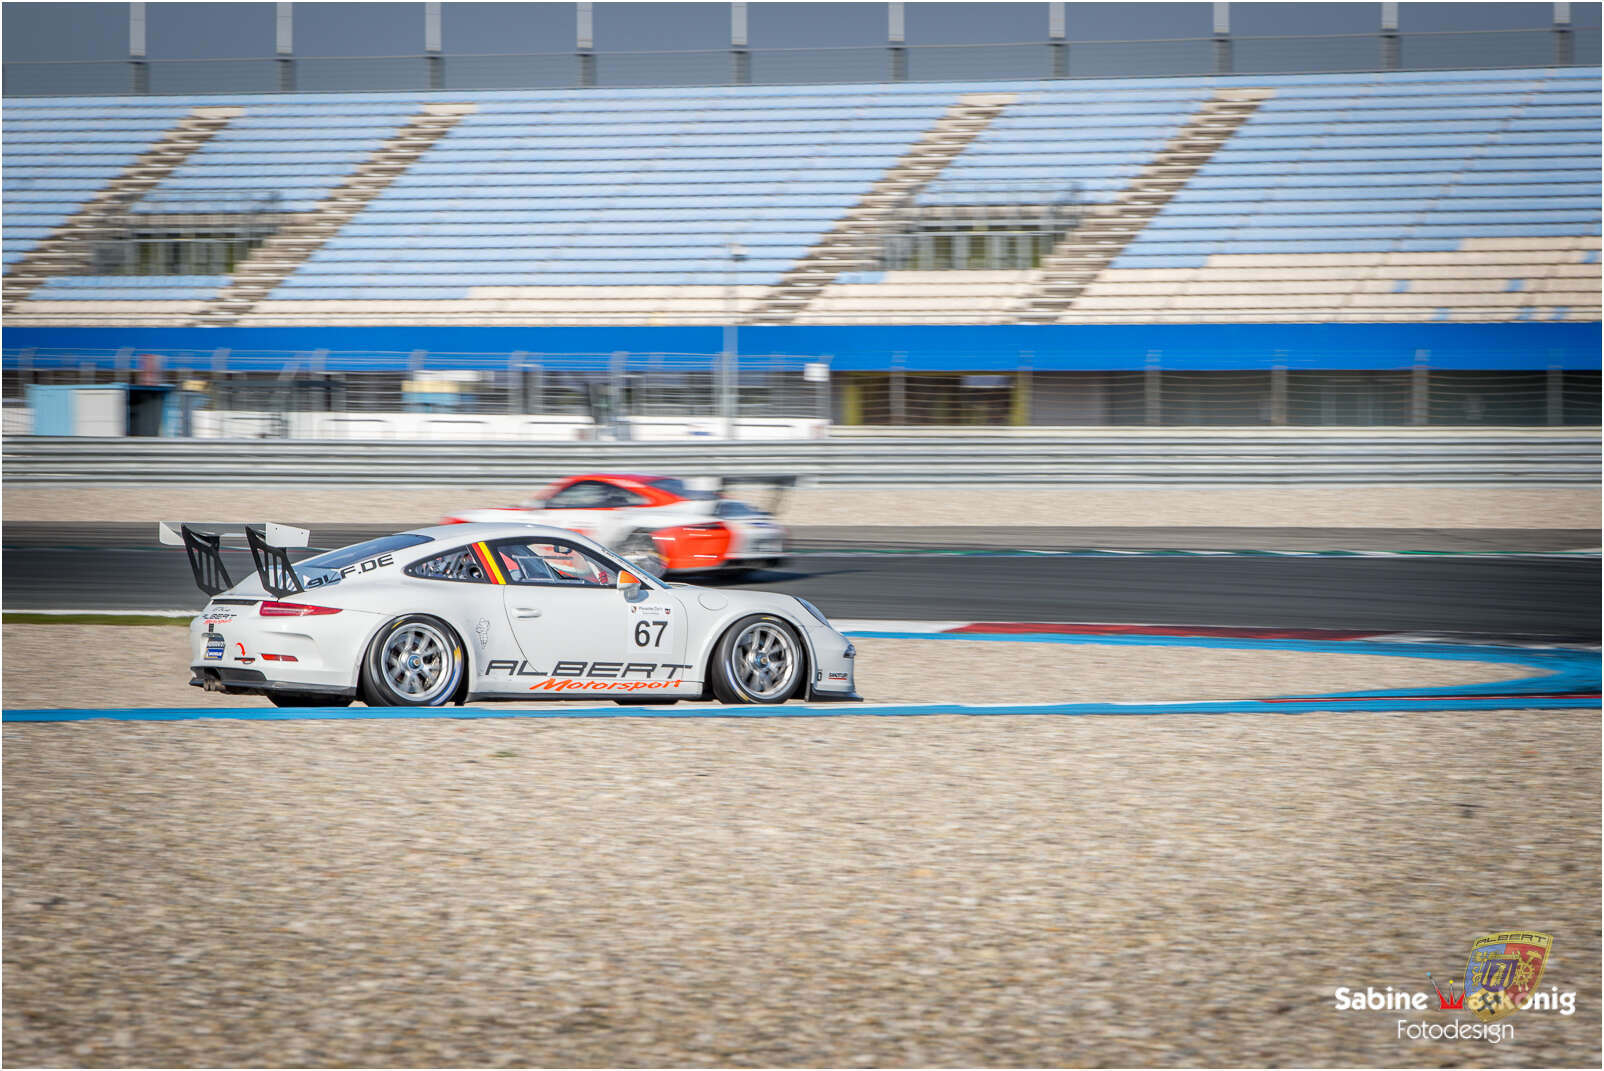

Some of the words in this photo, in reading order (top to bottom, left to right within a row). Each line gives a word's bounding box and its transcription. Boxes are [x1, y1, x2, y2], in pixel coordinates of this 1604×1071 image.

[634, 620, 668, 648] 67
[485, 660, 693, 679] ALBERT
[529, 678, 684, 692] Motorsport
